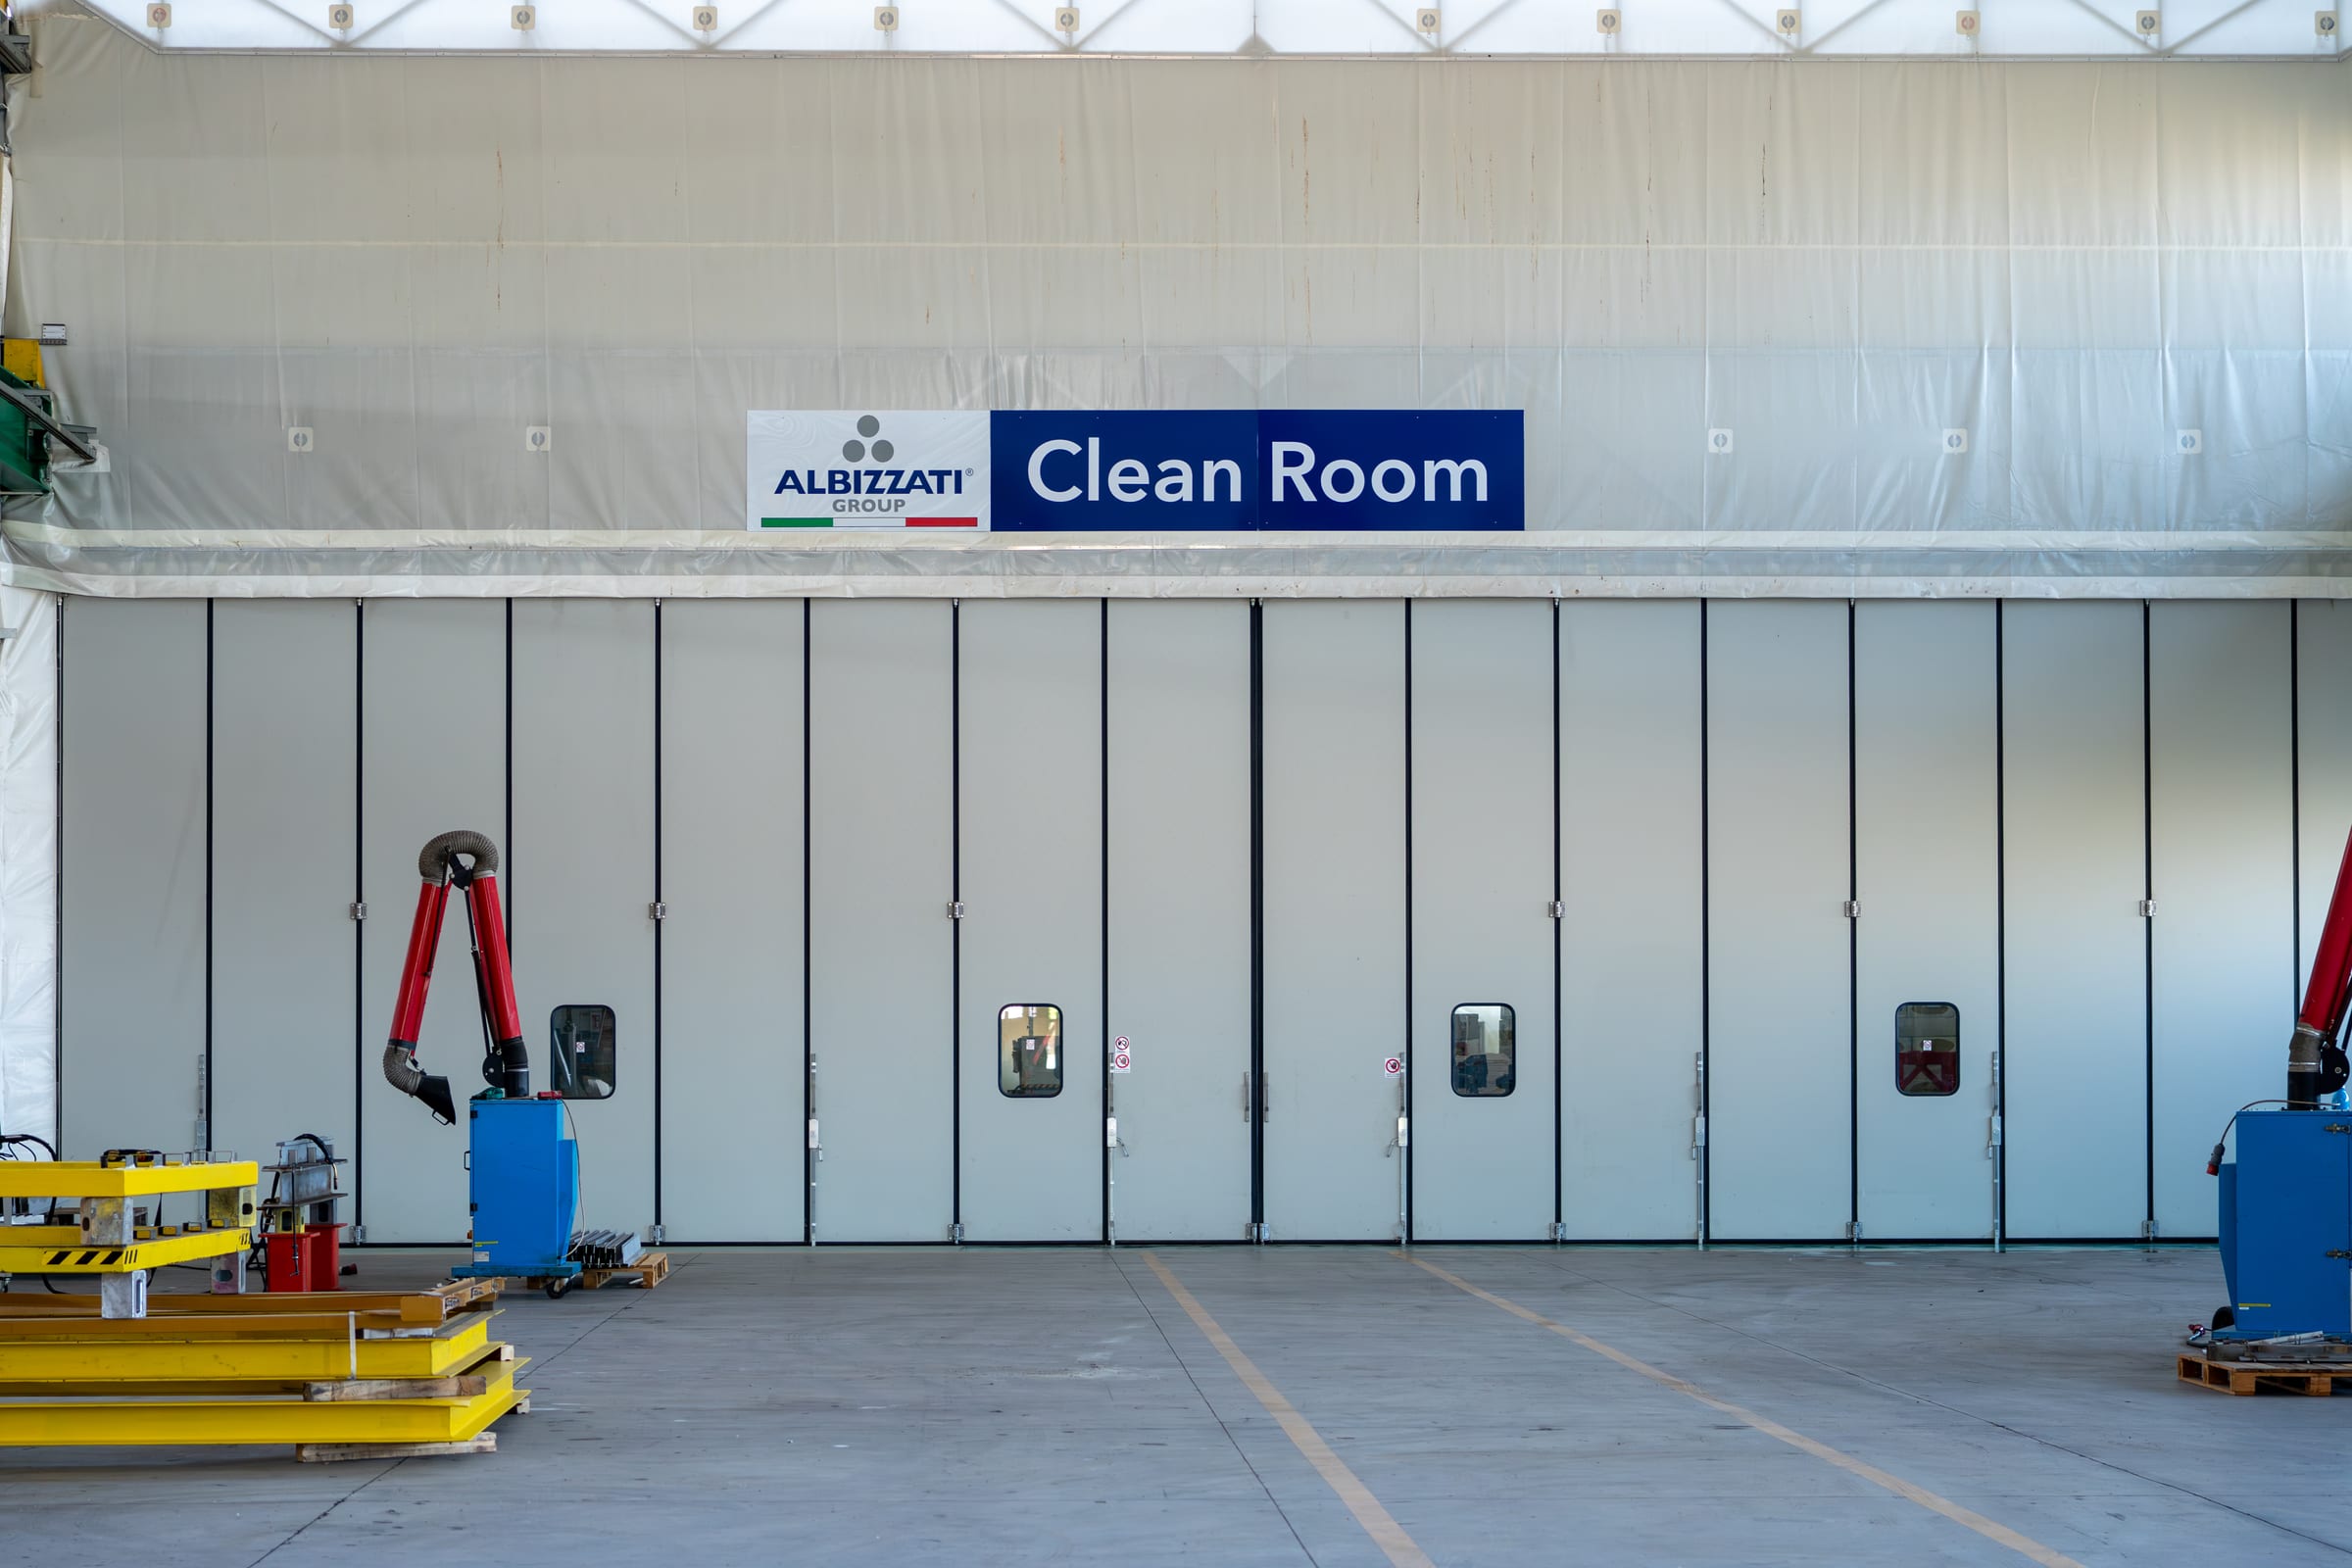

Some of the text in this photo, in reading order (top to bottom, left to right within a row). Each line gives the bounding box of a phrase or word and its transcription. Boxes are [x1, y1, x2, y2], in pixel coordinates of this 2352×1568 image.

[1027, 436, 1489, 503] Clean Room
[831, 498, 906, 514] GROUP
